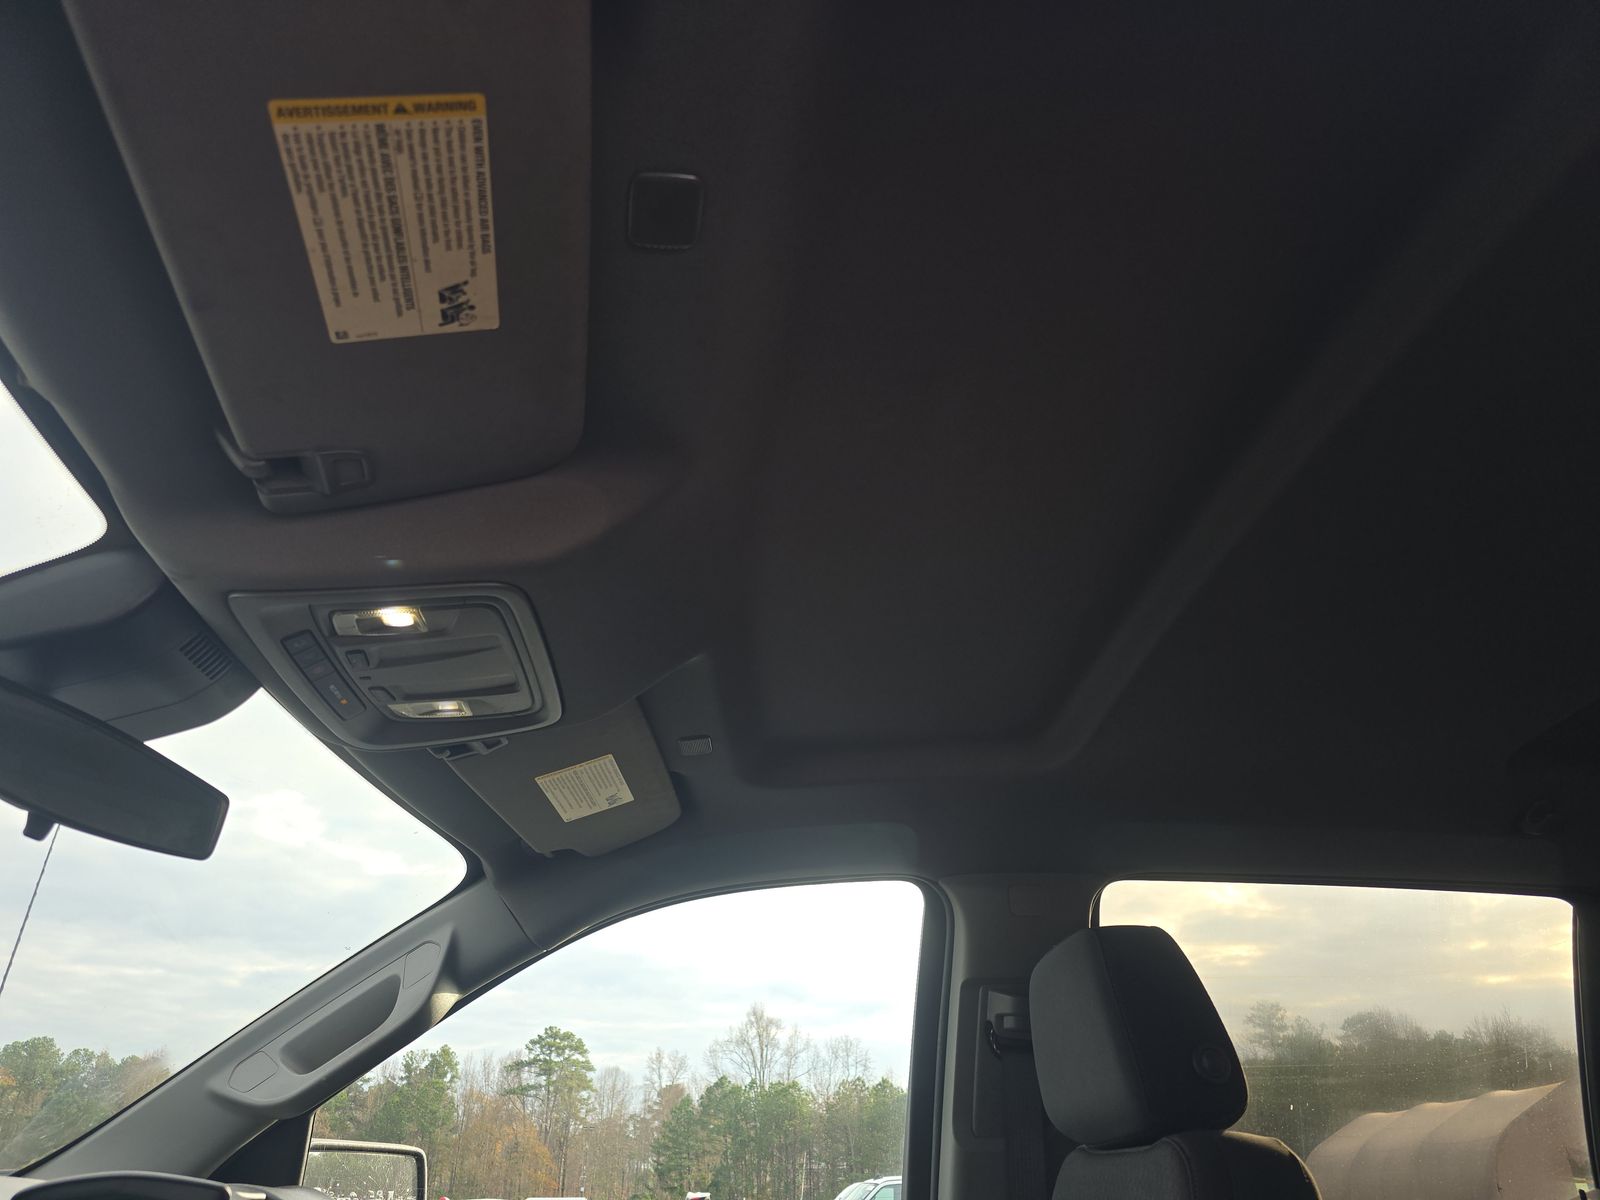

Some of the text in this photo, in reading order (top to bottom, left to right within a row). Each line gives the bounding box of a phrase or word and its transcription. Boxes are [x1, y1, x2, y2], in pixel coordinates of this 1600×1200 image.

[275, 102, 388, 118] AVERTISSEMENT
[413, 99, 477, 113] WARNING
[473, 146, 485, 168] WITH
[476, 170, 488, 216] ADVANCED
